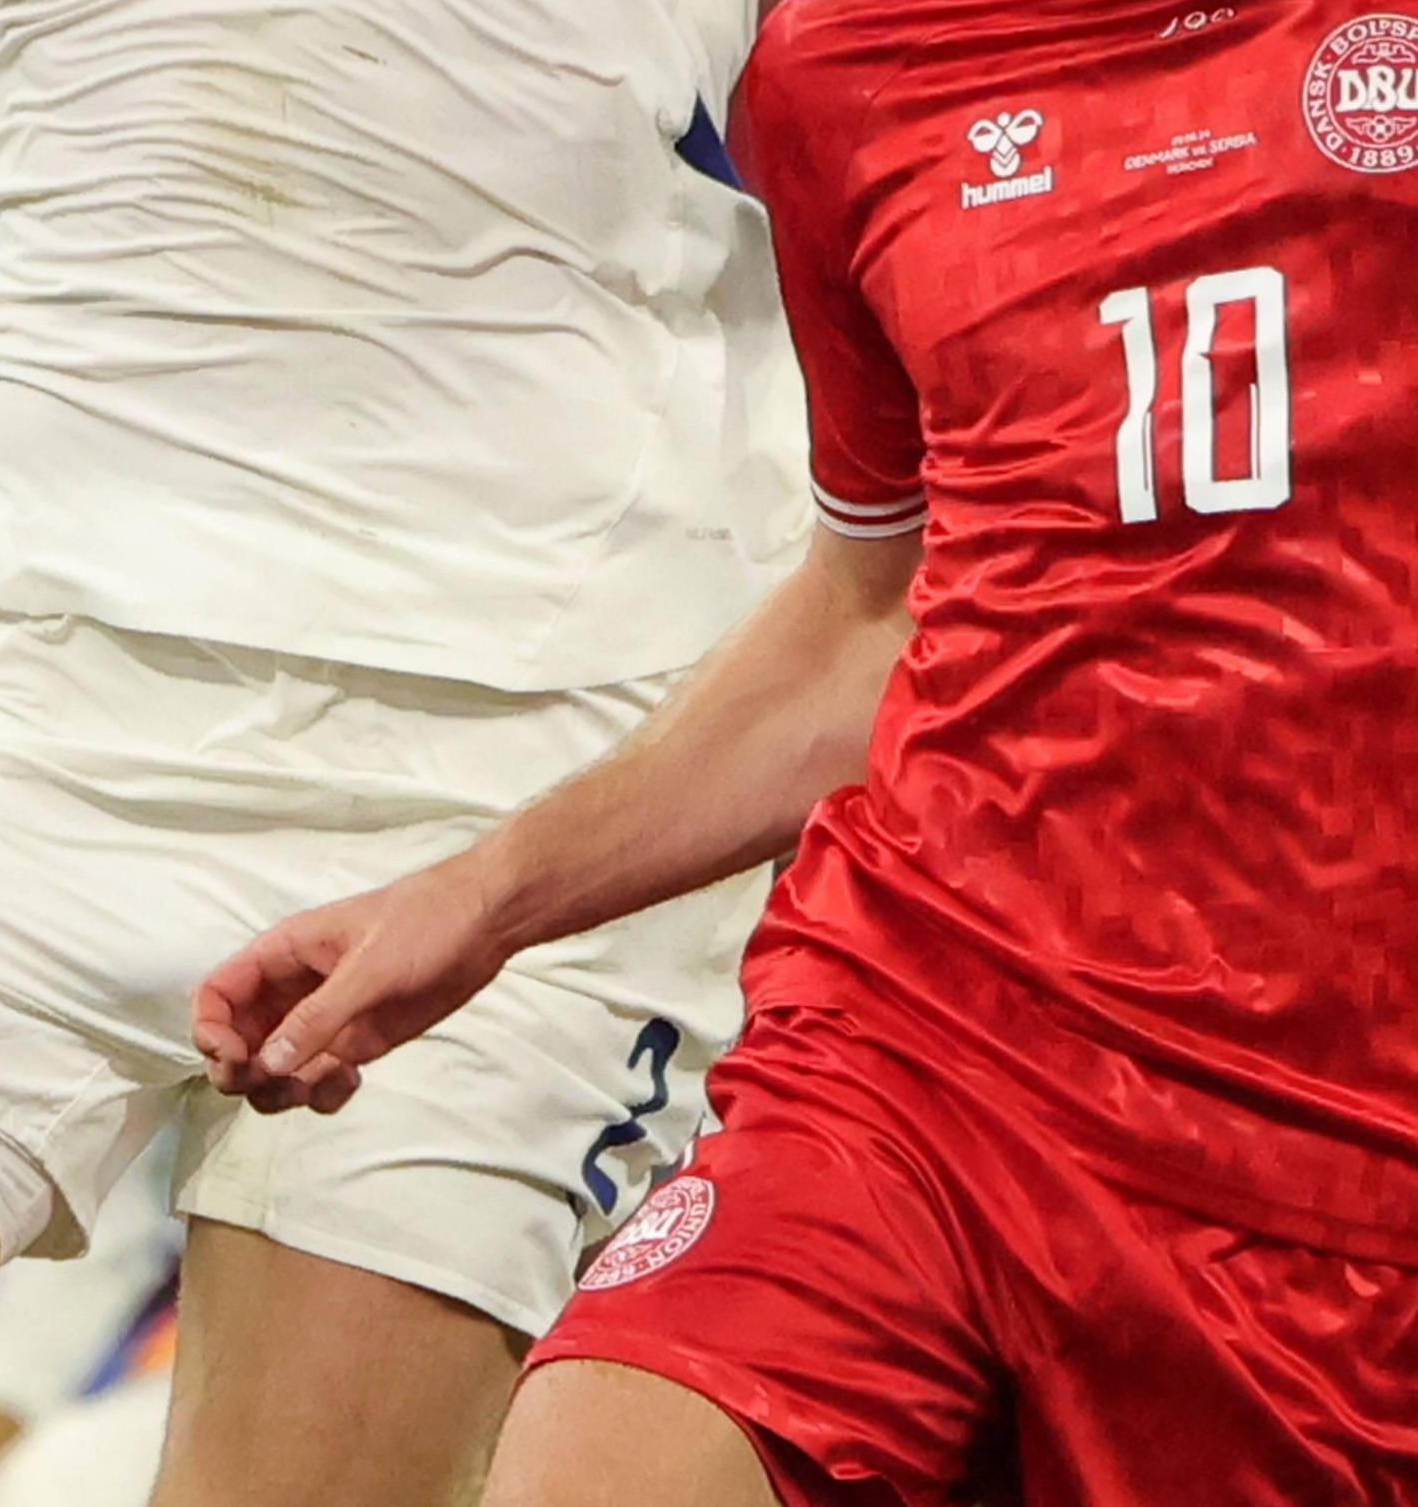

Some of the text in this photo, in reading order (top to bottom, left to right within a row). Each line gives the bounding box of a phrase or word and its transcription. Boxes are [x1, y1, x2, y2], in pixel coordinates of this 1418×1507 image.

[1309, 60, 1344, 151] DANSK
[962, 166, 1052, 209] hummel
[1124, 147, 1189, 170] DENMARK
[1349, 145, 1414, 167] 1889
[1099, 265, 1291, 524] 10
[582, 1017, 680, 1217] 2
